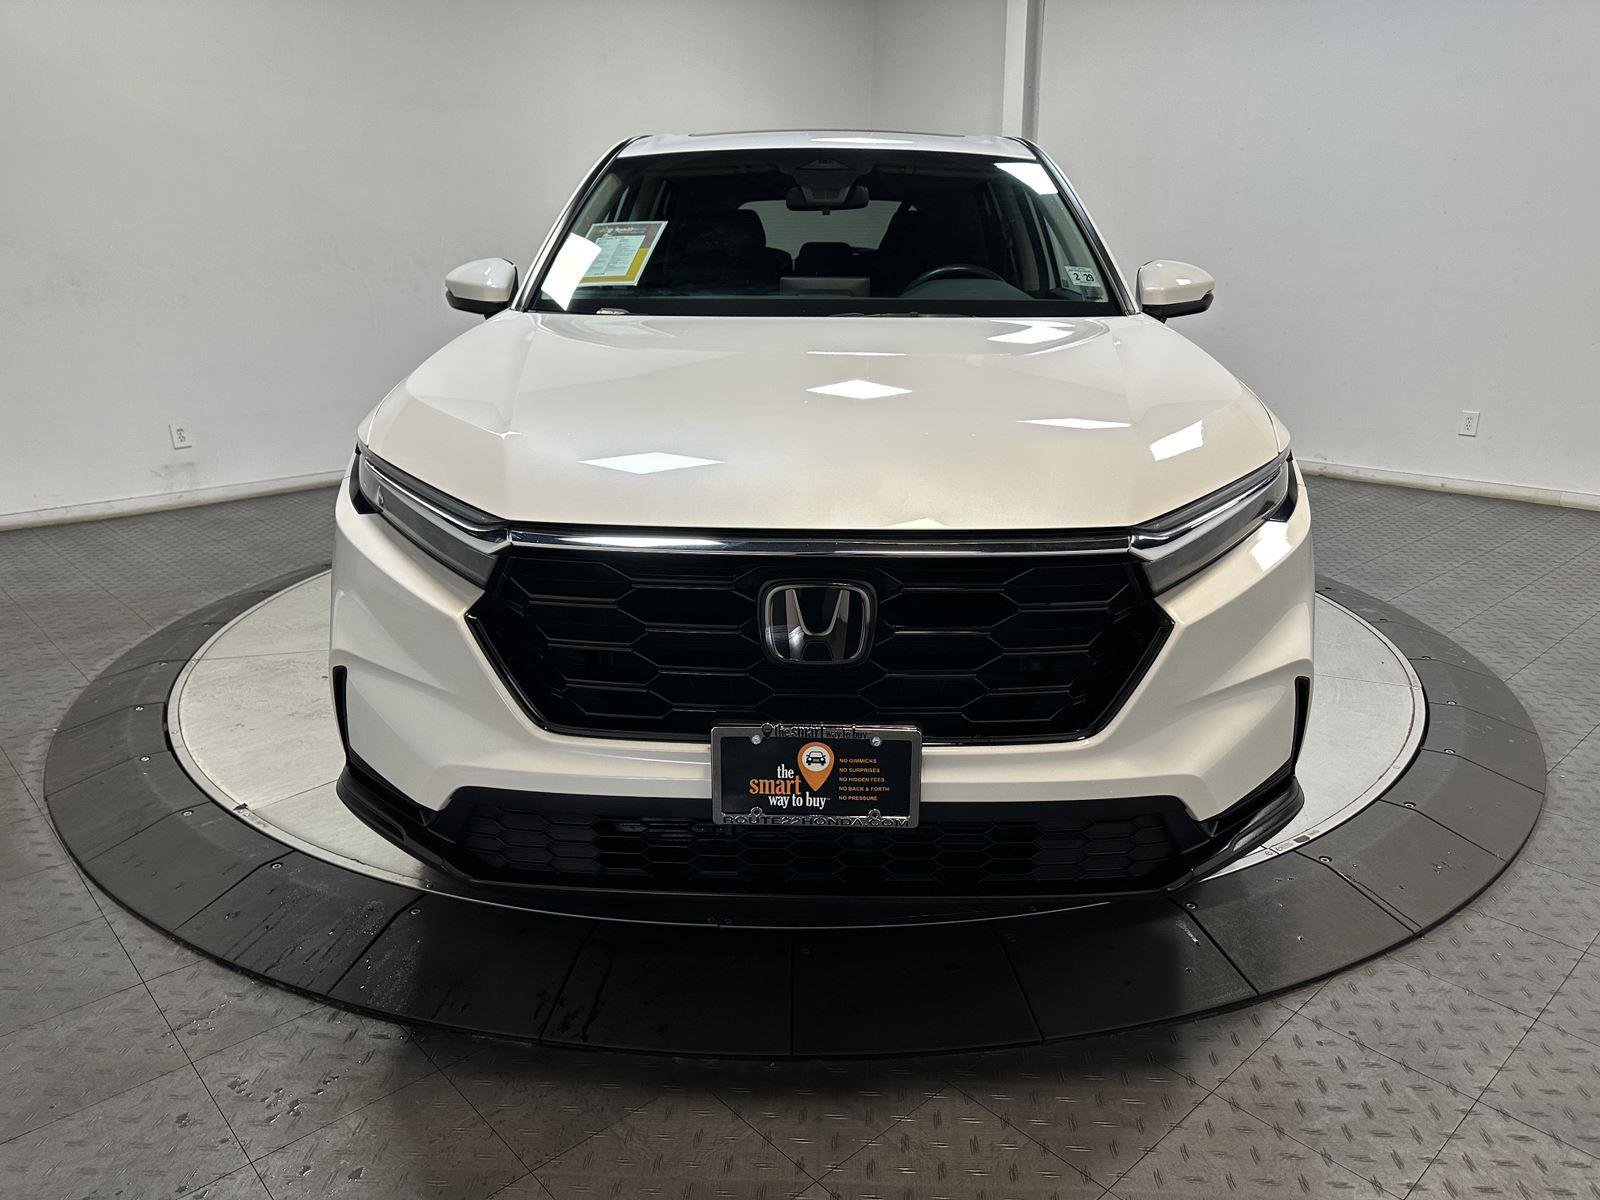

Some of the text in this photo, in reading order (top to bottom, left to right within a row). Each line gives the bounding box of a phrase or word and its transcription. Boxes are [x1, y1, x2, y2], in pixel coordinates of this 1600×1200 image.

[1073, 272, 1081, 281] 2
[776, 763, 795, 779] the
[749, 776, 802, 795] smart
[767, 795, 790, 809] way
[791, 793, 804, 807] to
